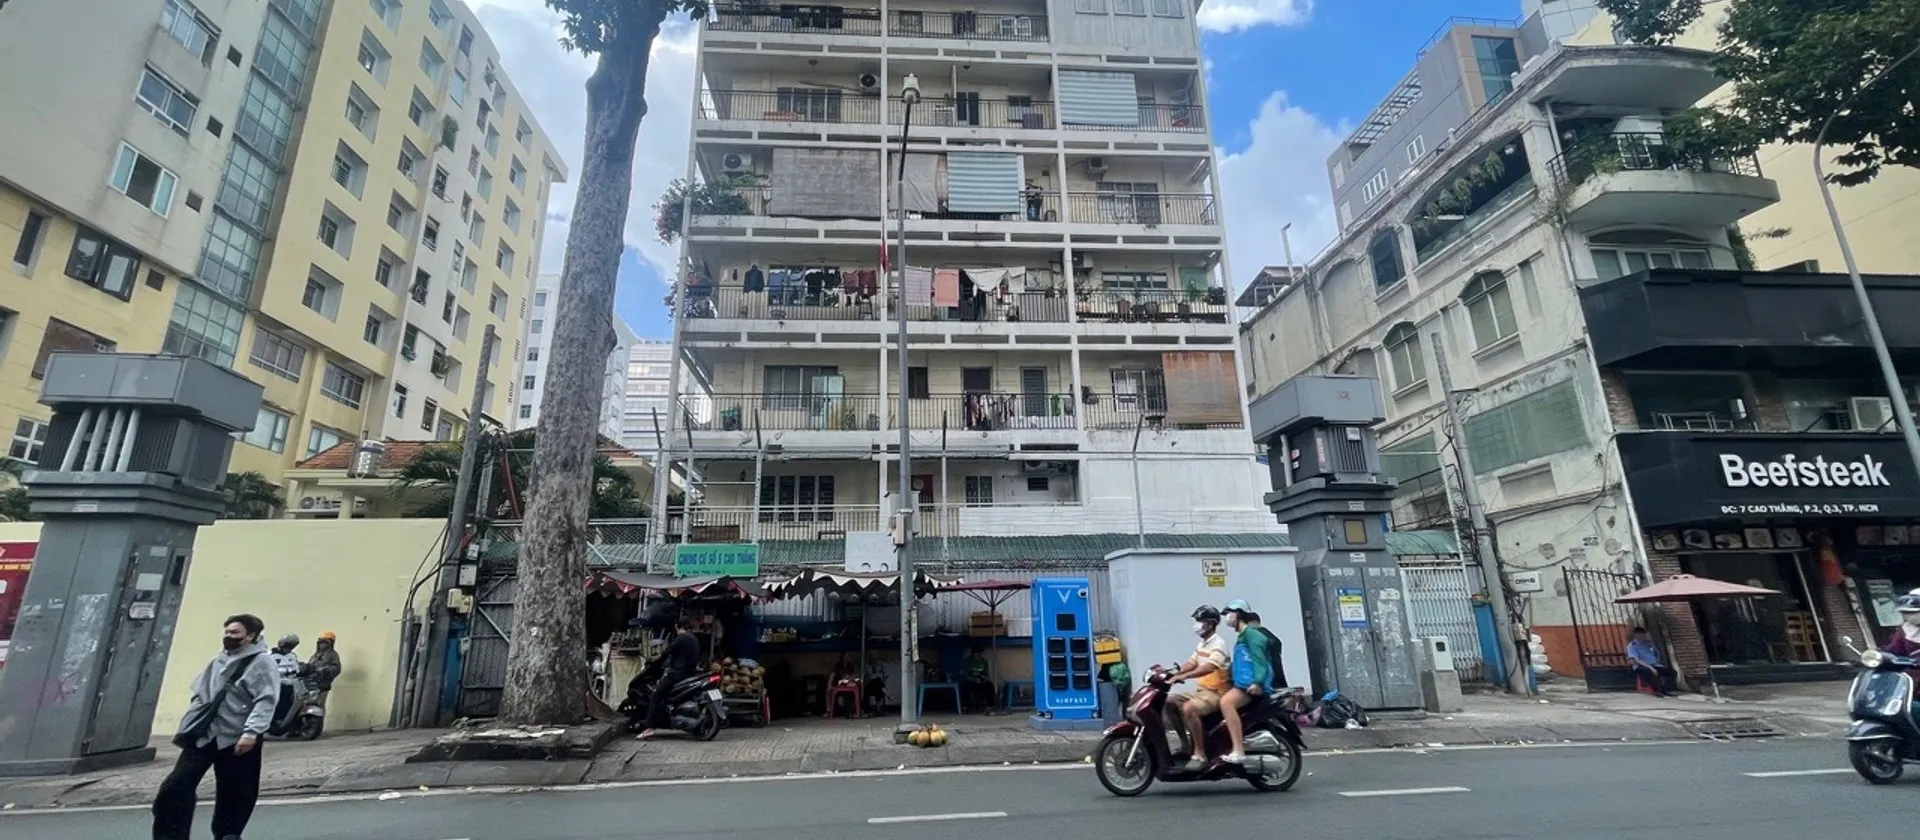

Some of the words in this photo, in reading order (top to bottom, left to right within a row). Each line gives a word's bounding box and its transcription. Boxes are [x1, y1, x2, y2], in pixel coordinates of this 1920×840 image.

[1719, 453, 1890, 487] Beefsteak
[1739, 505, 1746, 513] 7
[1747, 505, 1767, 513] CAO
